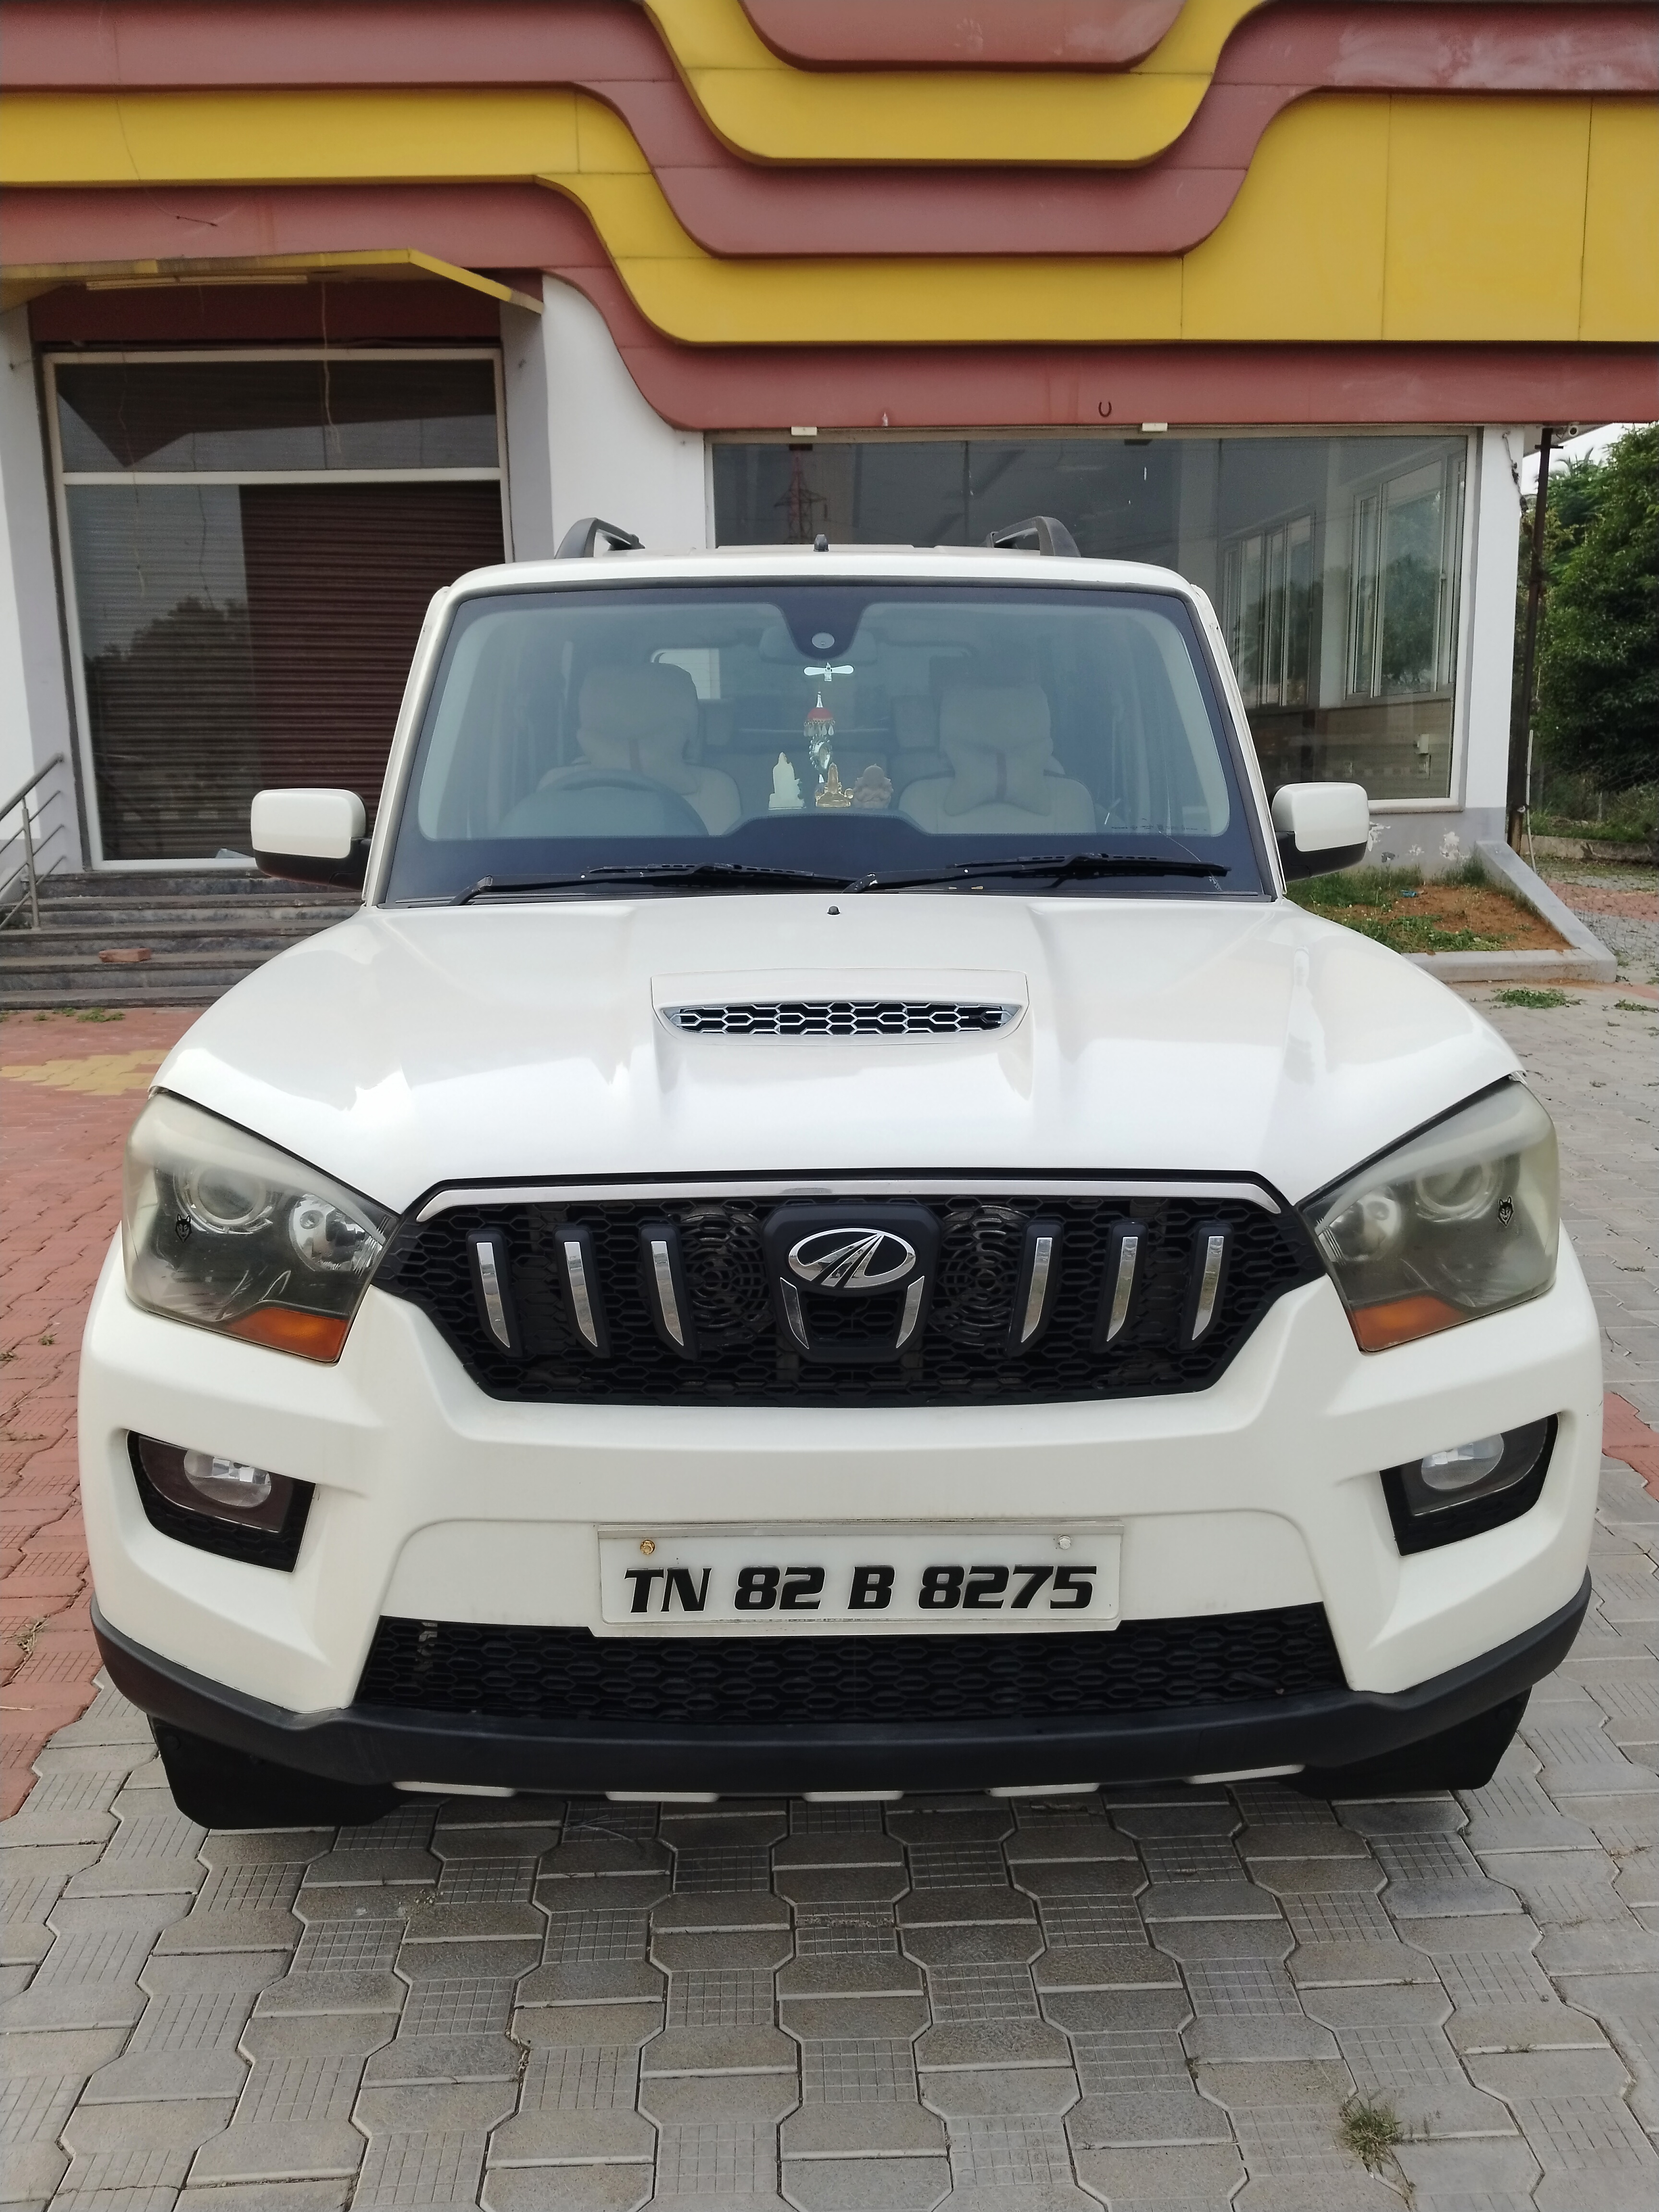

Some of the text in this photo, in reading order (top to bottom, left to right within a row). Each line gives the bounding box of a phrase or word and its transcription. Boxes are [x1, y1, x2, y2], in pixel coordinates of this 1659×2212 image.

[624, 1565, 1097, 1612] TN 82 B 8275
